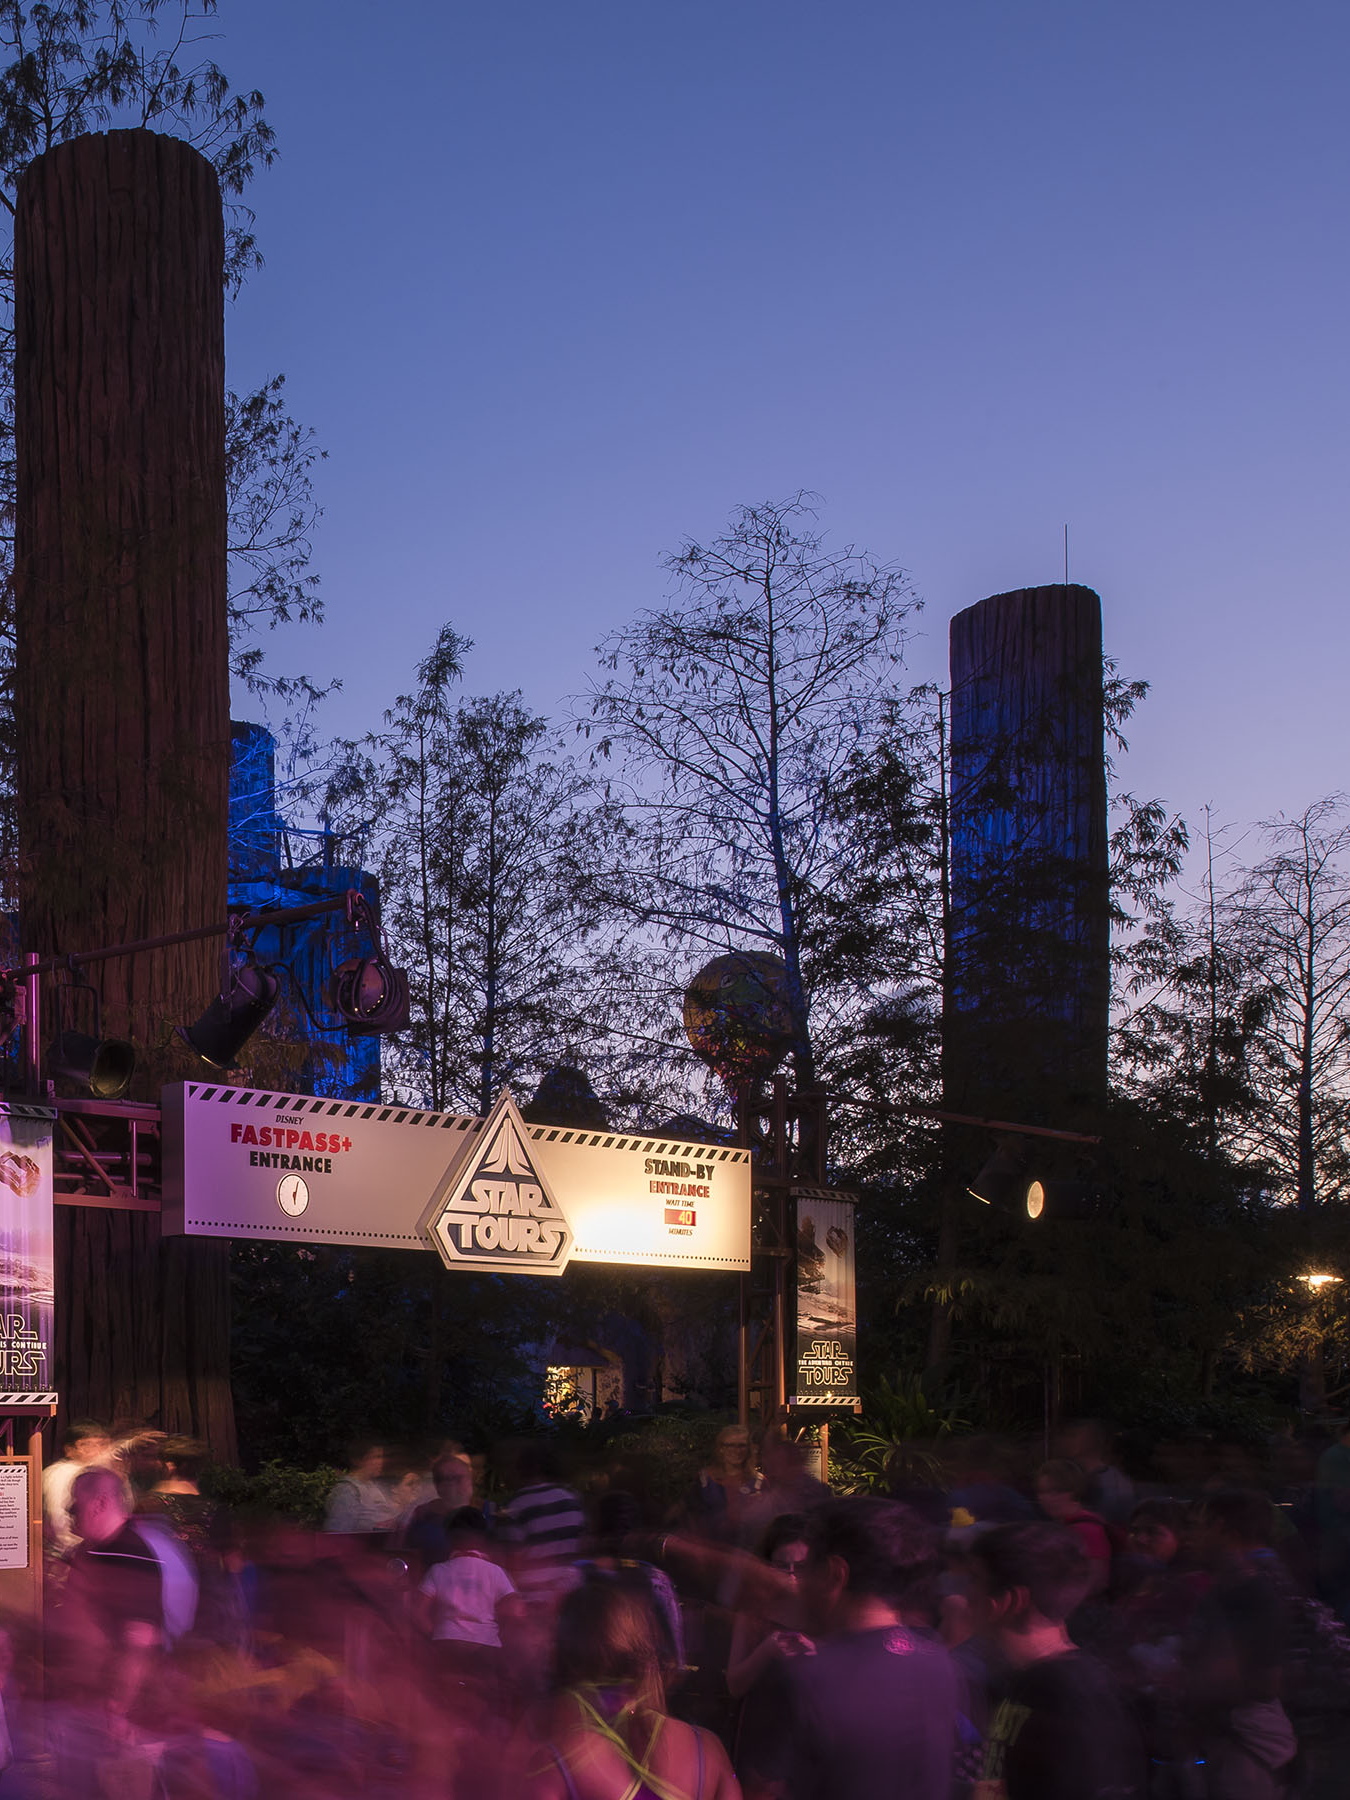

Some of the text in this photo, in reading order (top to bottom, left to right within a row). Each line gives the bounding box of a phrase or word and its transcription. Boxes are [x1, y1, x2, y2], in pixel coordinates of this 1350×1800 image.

[276, 1114, 304, 1125] DISNEY
[230, 1123, 352, 1154] FASTPASS+
[250, 1150, 332, 1174] ENTRANCE
[644, 1158, 715, 1180] STAND-BY
[649, 1180, 710, 1198] ENTRANCE
[449, 1179, 561, 1219] STAR
[682, 1200, 695, 1208] TIME
[678, 1210, 692, 1224] 40
[444, 1215, 567, 1254] TOURS
[668, 1228, 693, 1236] MINUTES
[803, 1340, 849, 1359] STAR
[798, 1366, 853, 1386] TOURS
